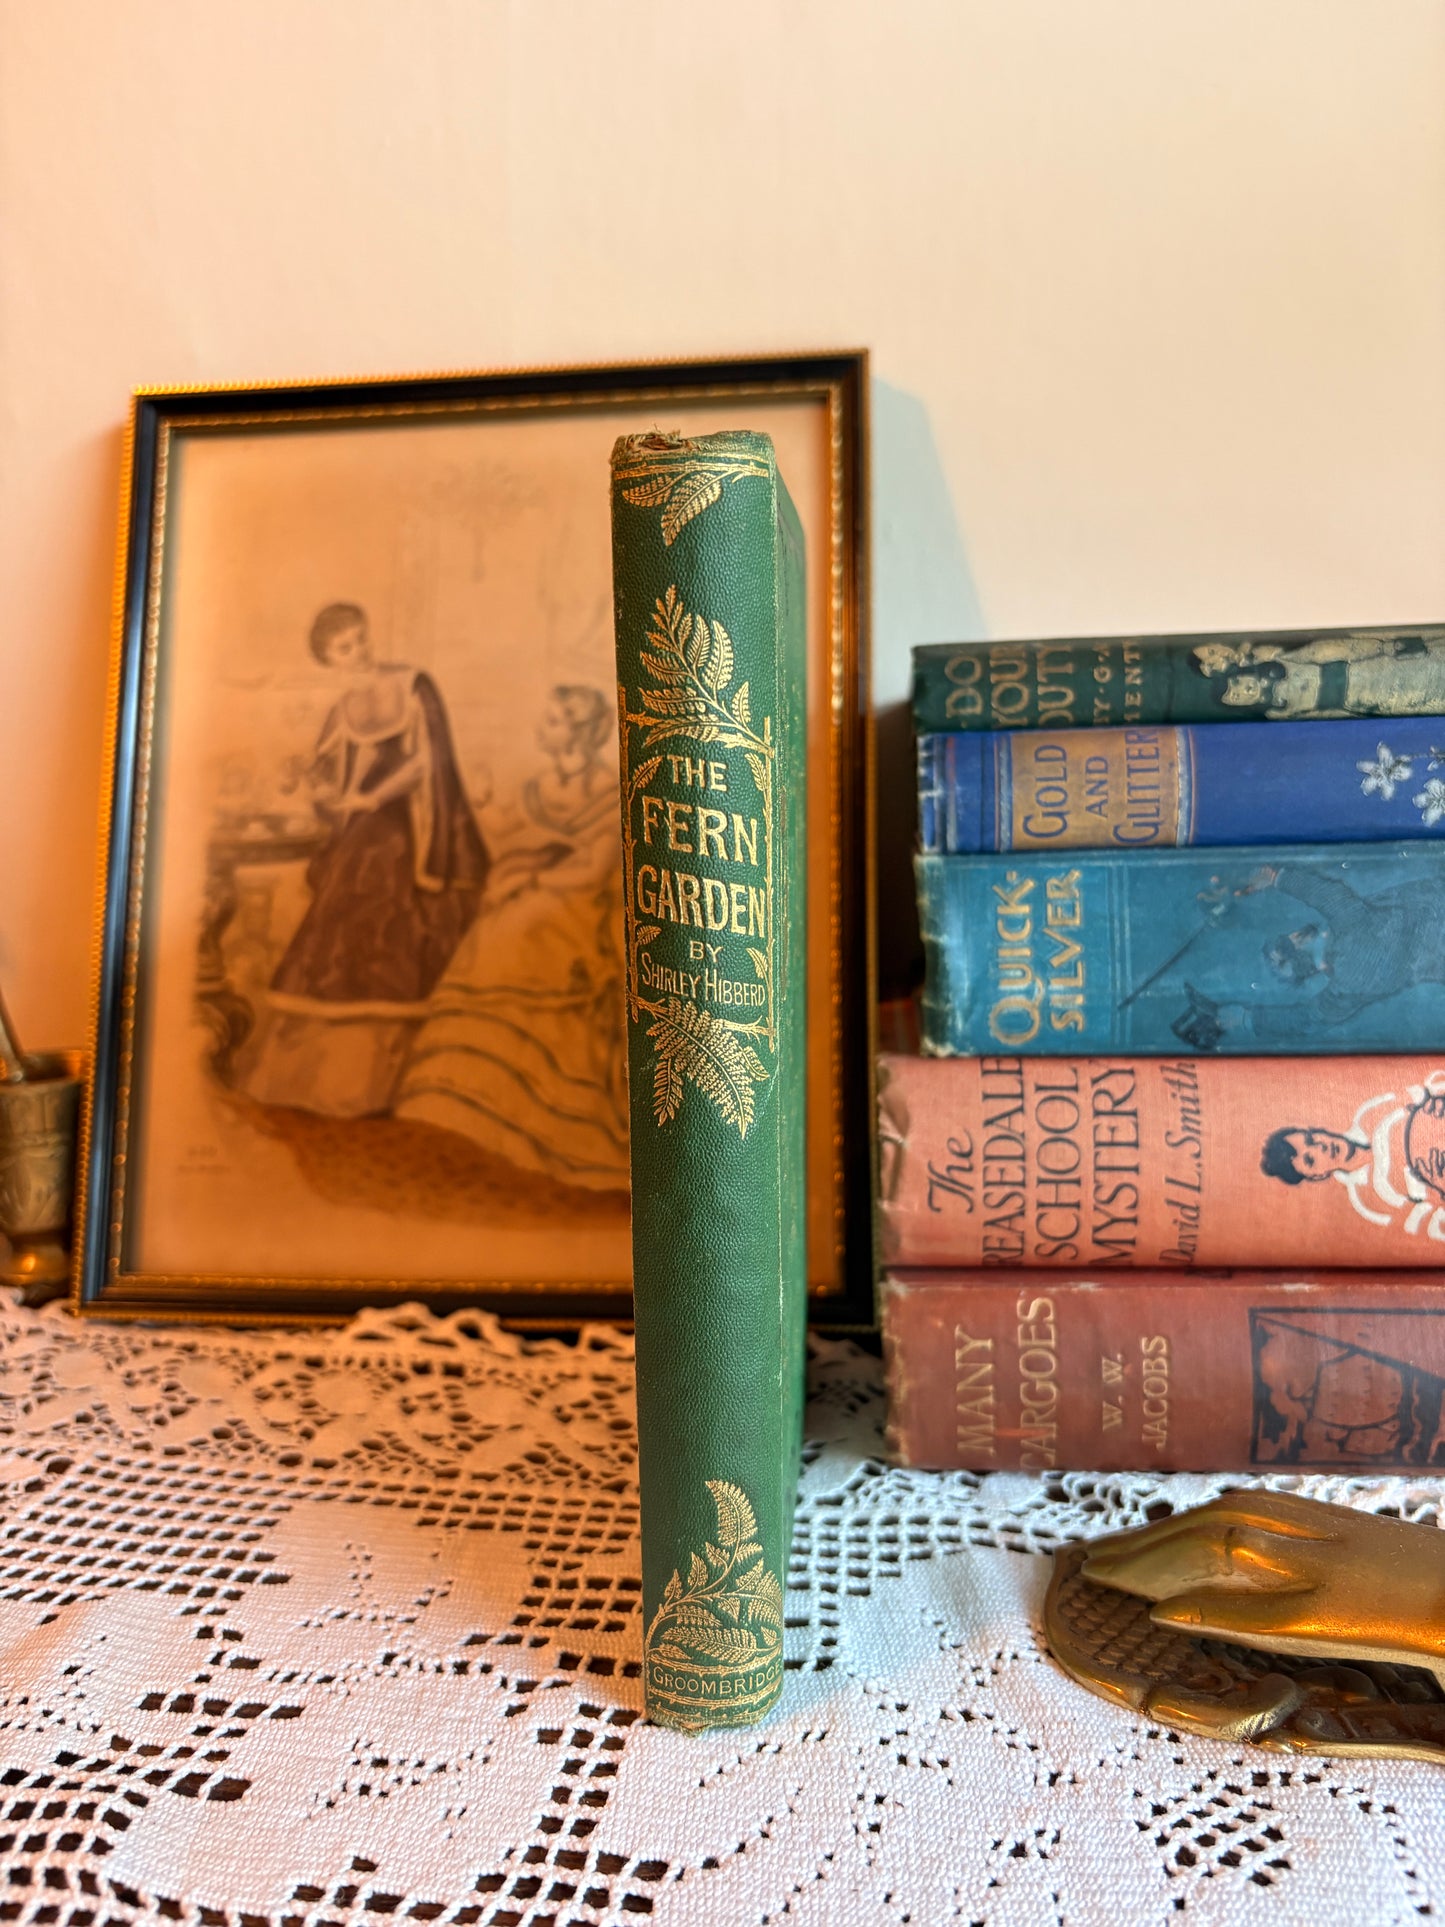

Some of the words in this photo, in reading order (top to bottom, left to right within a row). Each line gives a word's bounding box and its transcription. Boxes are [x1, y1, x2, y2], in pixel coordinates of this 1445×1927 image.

[944, 655, 983, 719] DO
[666, 754, 728, 792] THE
[1022, 744, 1068, 839] GOLD
[1085, 755, 1109, 819] AND
[1112, 729, 1160, 844] GLITTER
[641, 795, 759, 866] FERN
[636, 864, 767, 939] GARDEN
[641, 951, 702, 999] SHIRLEY
[704, 968, 767, 1006] HIBBERD
[689, 940, 724, 963] BY
[1043, 868, 1086, 1033] SILVER
[1159, 1061, 1203, 1159] Smith
[926, 1126, 975, 1214] The
[1034, 1066, 1083, 1262] SCHOOL
[1090, 1064, 1141, 1266] MYSTERY
[1164, 1160, 1203, 1194] L.
[1159, 1199, 1203, 1265] David
[954, 1324, 995, 1457] MANY
[1016, 1296, 1059, 1470] CARGOES
[1101, 1352, 1124, 1385] W.
[1141, 1334, 1170, 1452] JACOBS
[1102, 1394, 1124, 1432] W.
